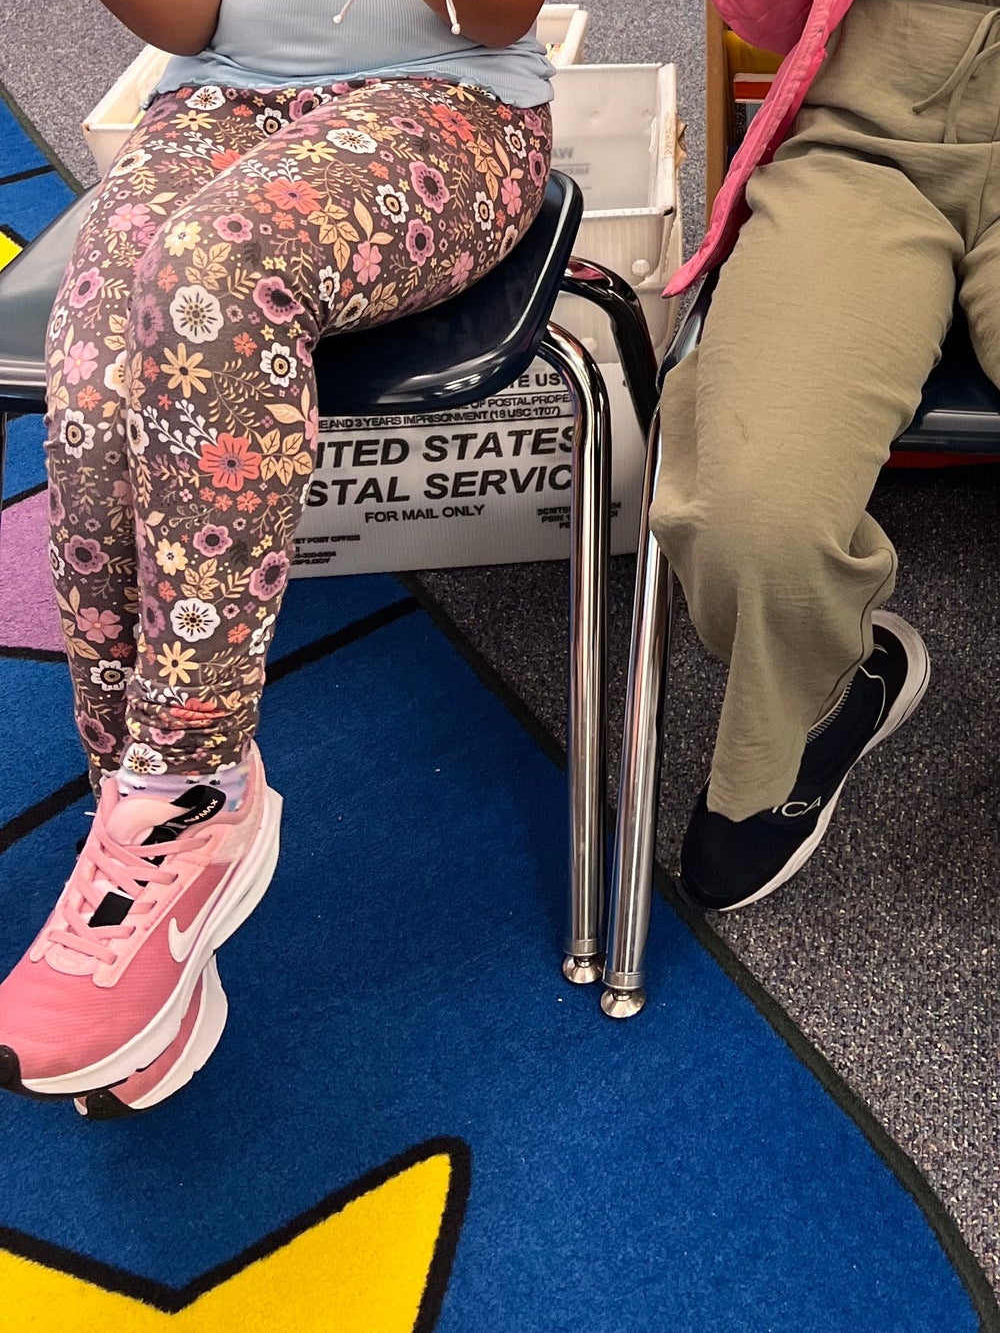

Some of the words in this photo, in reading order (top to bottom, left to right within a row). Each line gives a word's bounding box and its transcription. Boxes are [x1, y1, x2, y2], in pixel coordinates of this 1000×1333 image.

[488, 396, 530, 408] POSTAL
[330, 418, 355, 429] AND
[362, 415, 402, 427] YEARS
[403, 411, 488, 425] IMPRISONMENT
[508, 407, 531, 419] USC
[316, 437, 409, 470] ITED
[422, 425, 574, 463] STATES
[306, 476, 410, 507] STAL
[424, 465, 572, 499] SERVIC
[365, 510, 398, 523] FOR
[401, 508, 439, 522] MAIL
[445, 504, 485, 518] ONLY
